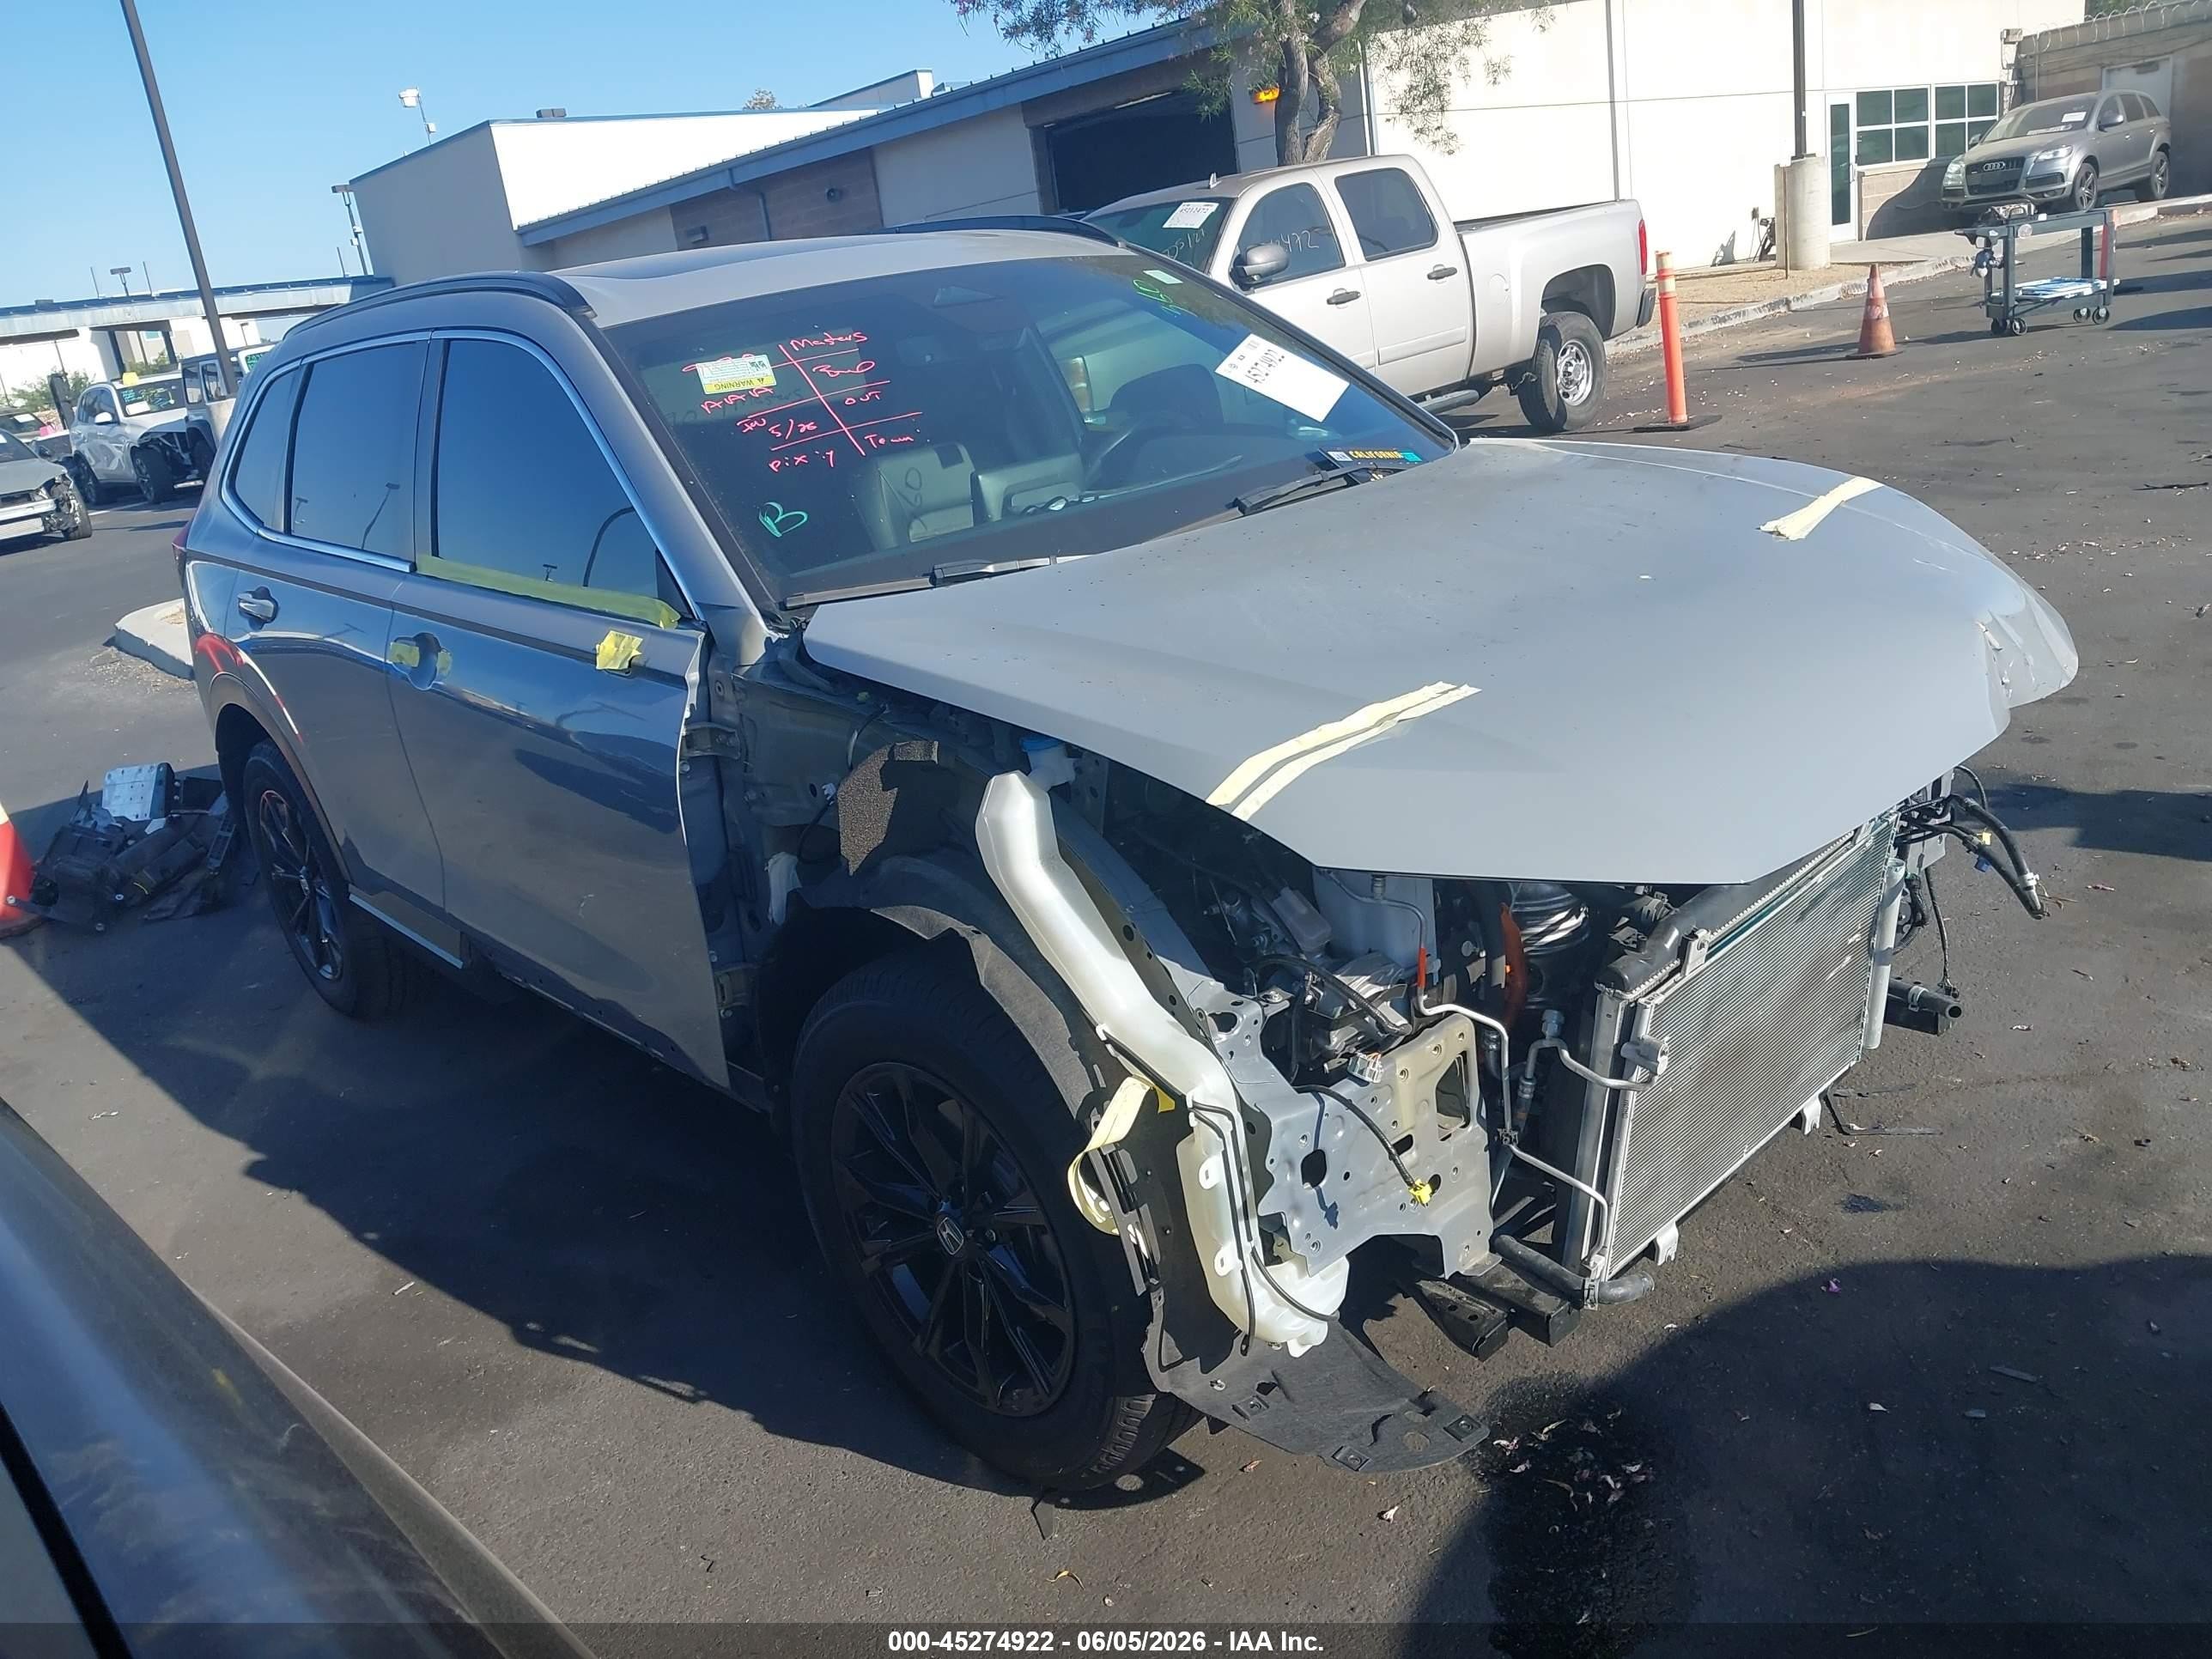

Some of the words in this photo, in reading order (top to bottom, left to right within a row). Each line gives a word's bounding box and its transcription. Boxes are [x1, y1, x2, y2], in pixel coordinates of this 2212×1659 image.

[1271, 230, 1319, 252] 472
[714, 379, 755, 391] WARNING
[701, 386, 775, 414] AAA
[844, 391, 882, 406] OUT
[1348, 450, 1405, 459] CALIFORNIA
